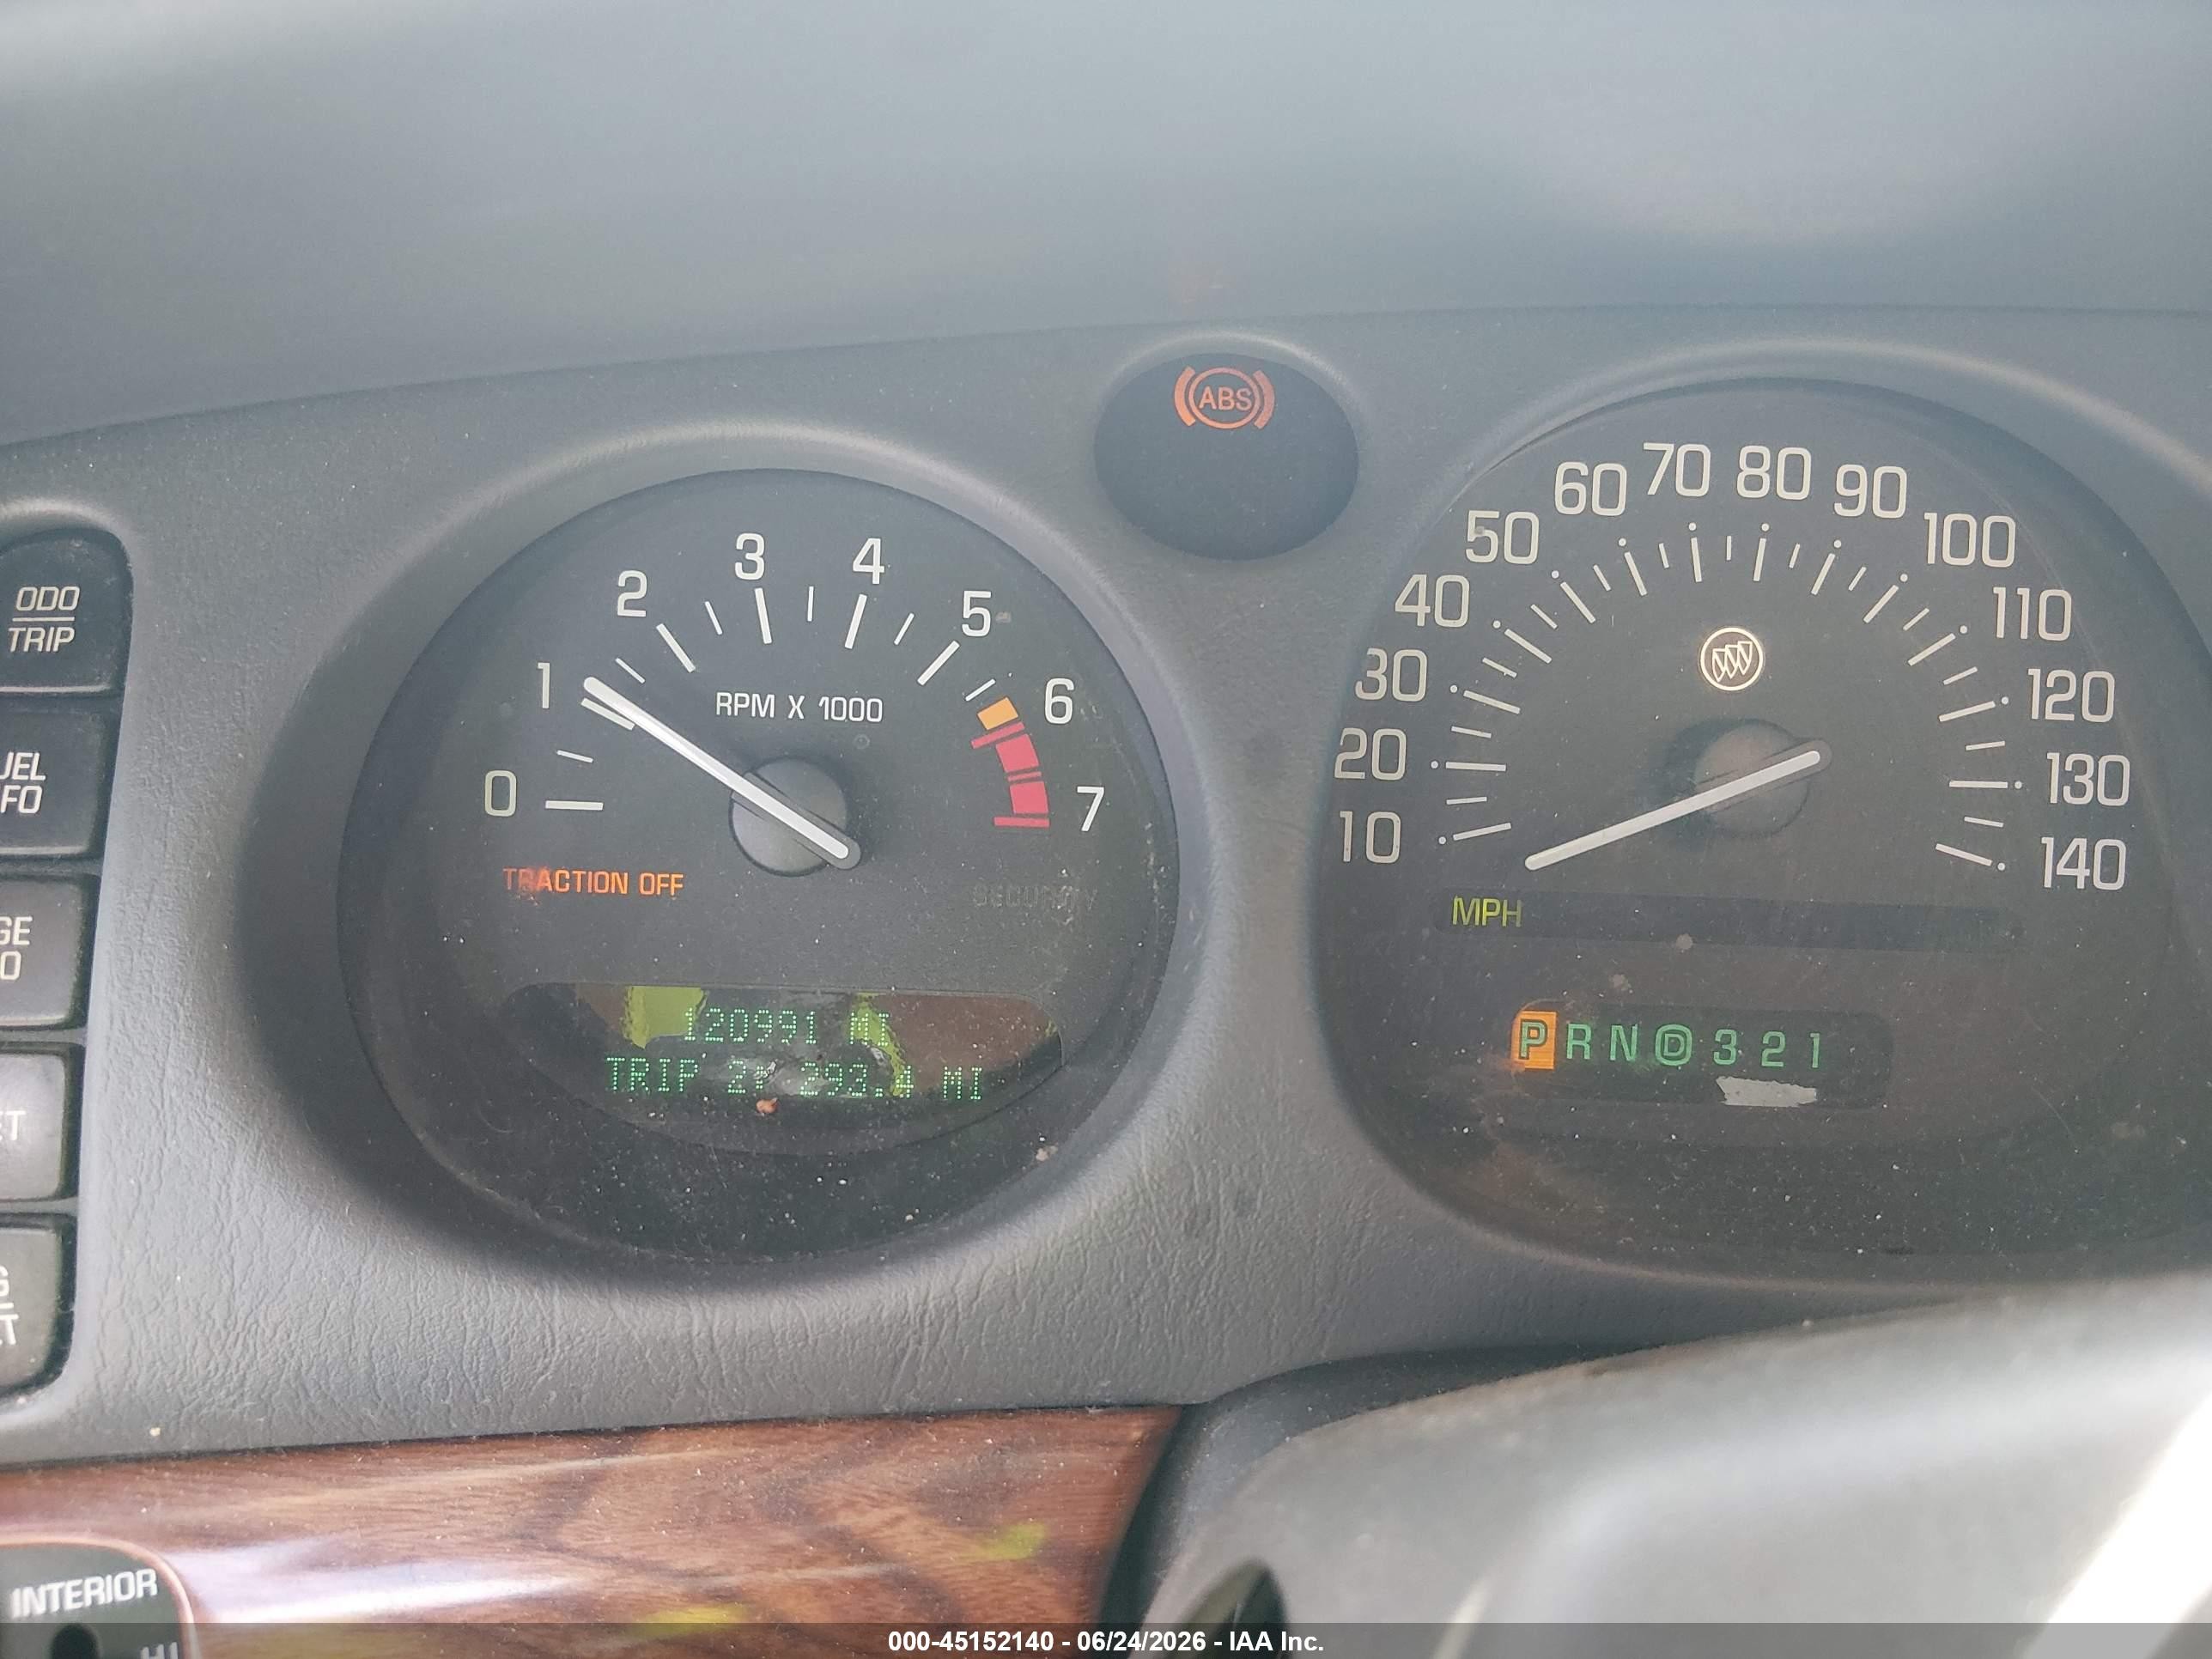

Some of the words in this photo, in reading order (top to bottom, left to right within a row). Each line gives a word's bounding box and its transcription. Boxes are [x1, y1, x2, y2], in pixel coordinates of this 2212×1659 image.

[1199, 386, 1252, 410] ABS
[1554, 461, 1627, 516] 60
[1643, 442, 1711, 497] 70
[1736, 445, 1812, 501] 80
[1834, 464, 1907, 519] 90
[734, 532, 765, 580] 3
[853, 538, 885, 585] 4
[1465, 510, 1540, 565] 50
[1923, 512, 2016, 568] 100
[15, 586, 80, 611] ODO
[617, 569, 647, 617] 2
[962, 590, 992, 637] 5
[1395, 574, 1470, 628] 40
[1993, 586, 2072, 641] 110
[9, 626, 75, 652] TRIP
[538, 662, 550, 709] 1
[1355, 647, 1427, 702] 30
[2027, 668, 2115, 723] 120
[716, 692, 775, 718] RPM
[787, 695, 805, 720] X
[818, 696, 883, 722] 1000
[1044, 678, 1074, 724] 6
[1334, 727, 1407, 781] 20
[484, 769, 517, 817] 0
[2046, 752, 2130, 806] 130
[1077, 786, 1104, 832] 7
[1340, 811, 1401, 864] 10
[502, 867, 629, 895] TRACTION
[640, 872, 684, 896] OFF
[2041, 836, 2127, 890] 140
[973, 884, 1098, 911] SECUY
[1452, 896, 1523, 927] MPH
[684, 1007, 817, 1043] 120991
[849, 1012, 889, 1045] MI
[1520, 1021, 1547, 1058] P
[1566, 1023, 1592, 1060] R
[1609, 1024, 1638, 1061] N
[1658, 1028, 1690, 1062] D
[1713, 1029, 1737, 1066] 3
[1761, 1030, 1786, 1067] 2
[1809, 1032, 1820, 1068] 1
[606, 1057, 699, 1092] TRIP
[799, 1062, 914, 1098] 293.4
[944, 1066, 982, 1099] MI
[10, 1568, 158, 1619] INTERIOR
